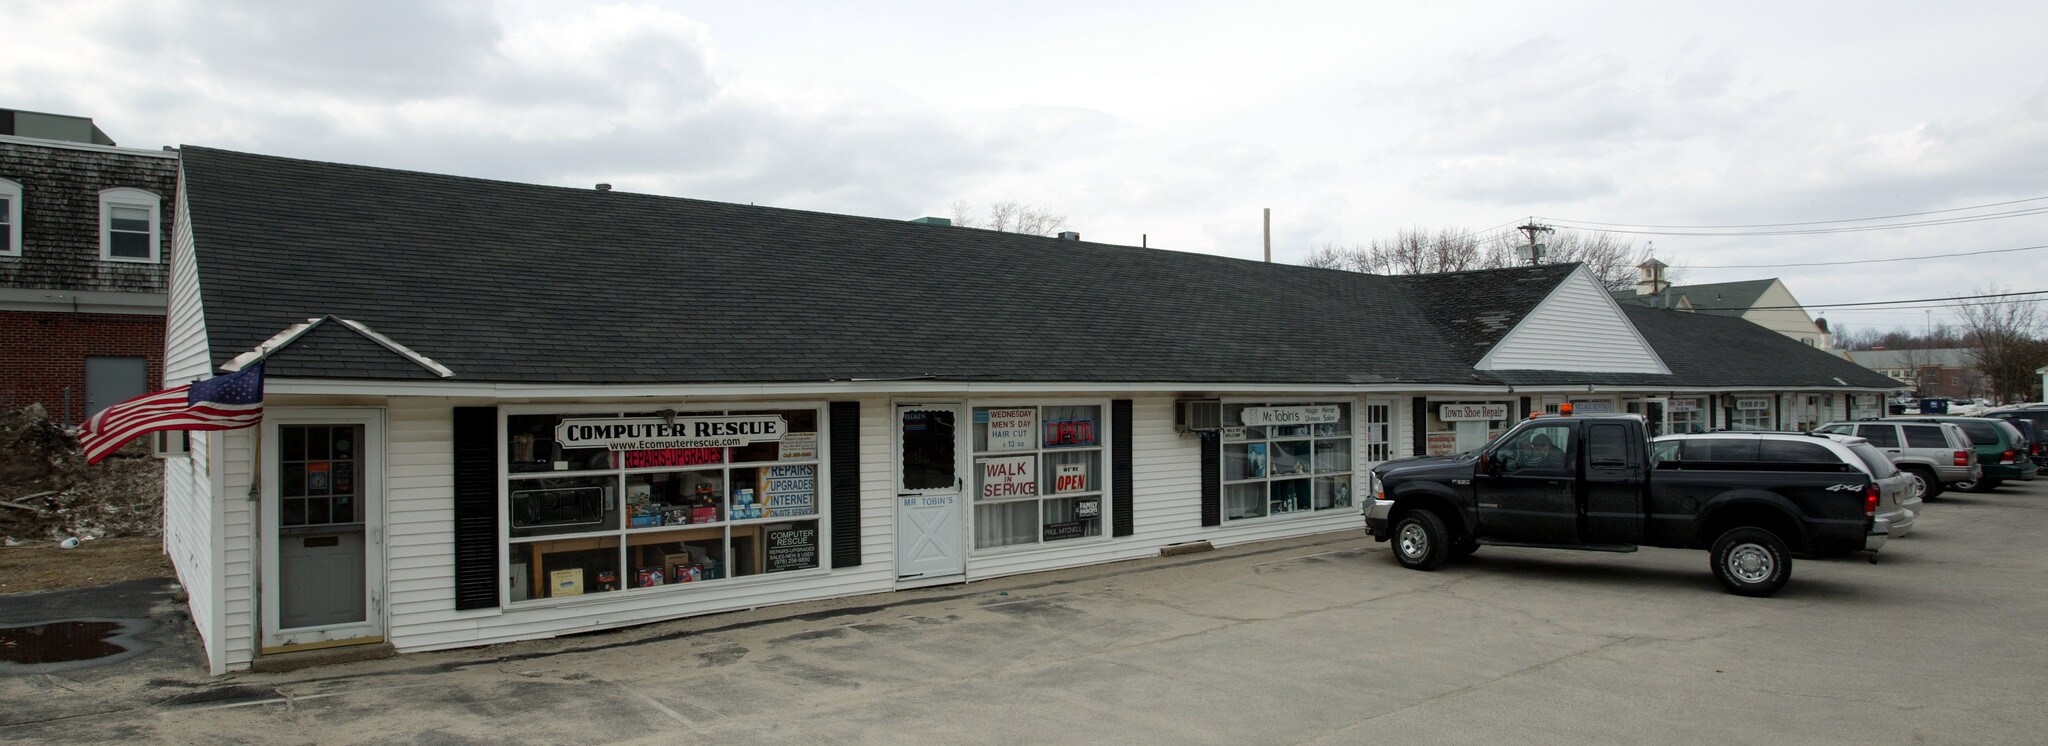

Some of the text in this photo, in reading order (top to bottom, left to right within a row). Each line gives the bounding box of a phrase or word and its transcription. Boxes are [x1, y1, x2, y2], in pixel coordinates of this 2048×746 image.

[990, 410, 1032, 418] WEDNESDAY
[1273, 410, 1300, 422] Tobin's
[1444, 406, 1504, 419] Town Shoe Repair
[567, 421, 777, 441] COMPUTER RESCUE
[992, 430, 1010, 438] HAIR
[1046, 421, 1093, 445] OPEN
[609, 437, 741, 451] www.Ecomputerrescue.com
[771, 464, 813, 477] REPAIRS
[987, 462, 1026, 477] WALK
[771, 479, 813, 491] UPGRADES
[1057, 474, 1085, 491] OPEN
[984, 482, 1036, 497] SERVICE
[771, 494, 814, 506] INTERNET
[904, 496, 953, 506] MR TOBIN'S
[1079, 501, 1098, 509] FAMILY
[792, 508, 813, 516] SERVICE
[771, 529, 814, 540] COMPUTER
[1058, 526, 1083, 534] MITCHELL
[776, 537, 808, 546] RESCUE
